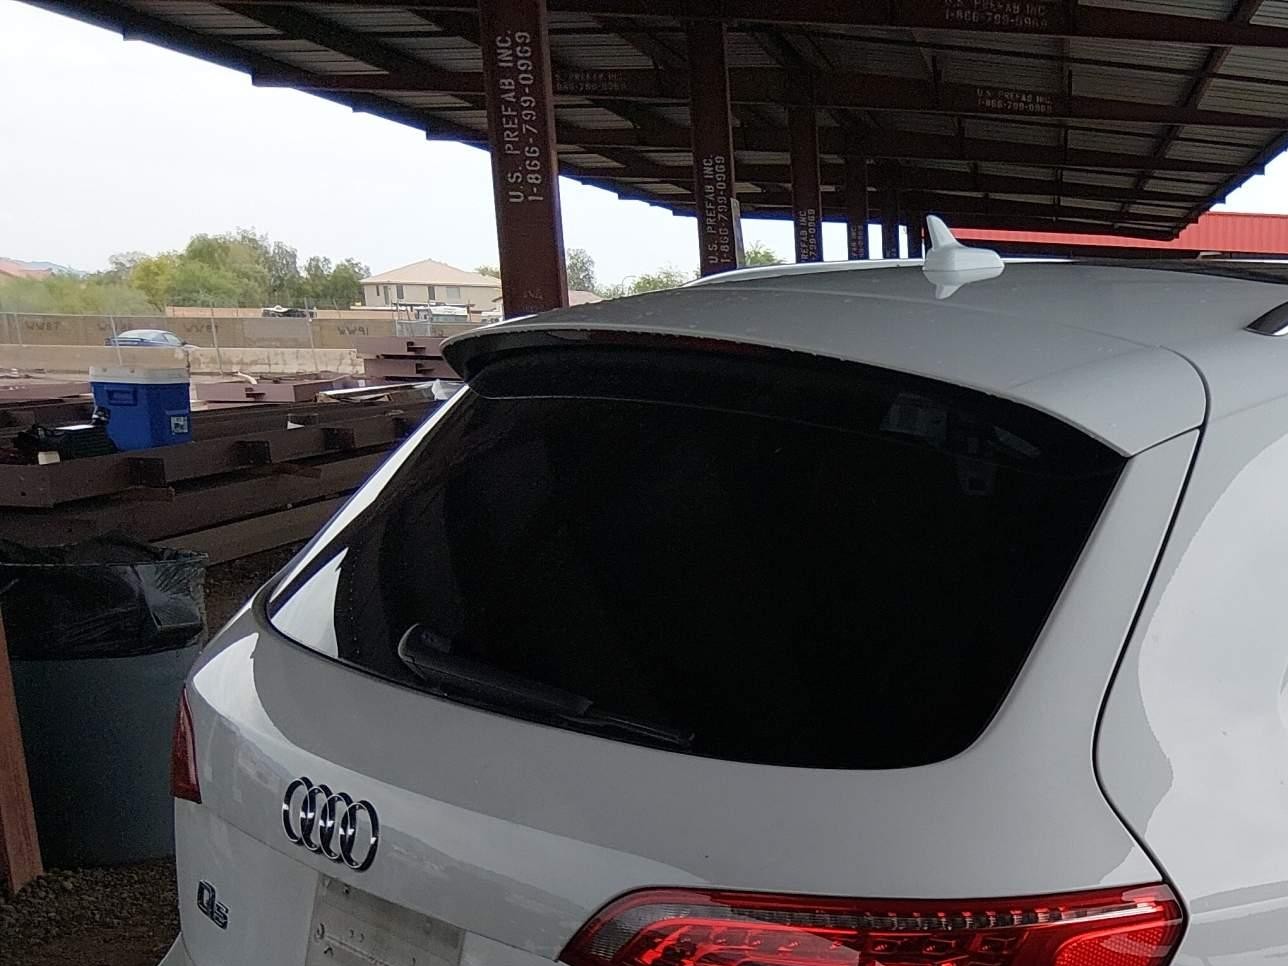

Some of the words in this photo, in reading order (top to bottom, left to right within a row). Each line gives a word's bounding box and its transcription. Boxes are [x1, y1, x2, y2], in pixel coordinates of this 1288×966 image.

[496, 30, 514, 67] INC.
[500, 78, 521, 156] PREFAB
[508, 165, 525, 203] U.S.
[703, 184, 717, 234] PREFAB
[197, 880, 230, 930] Q5
